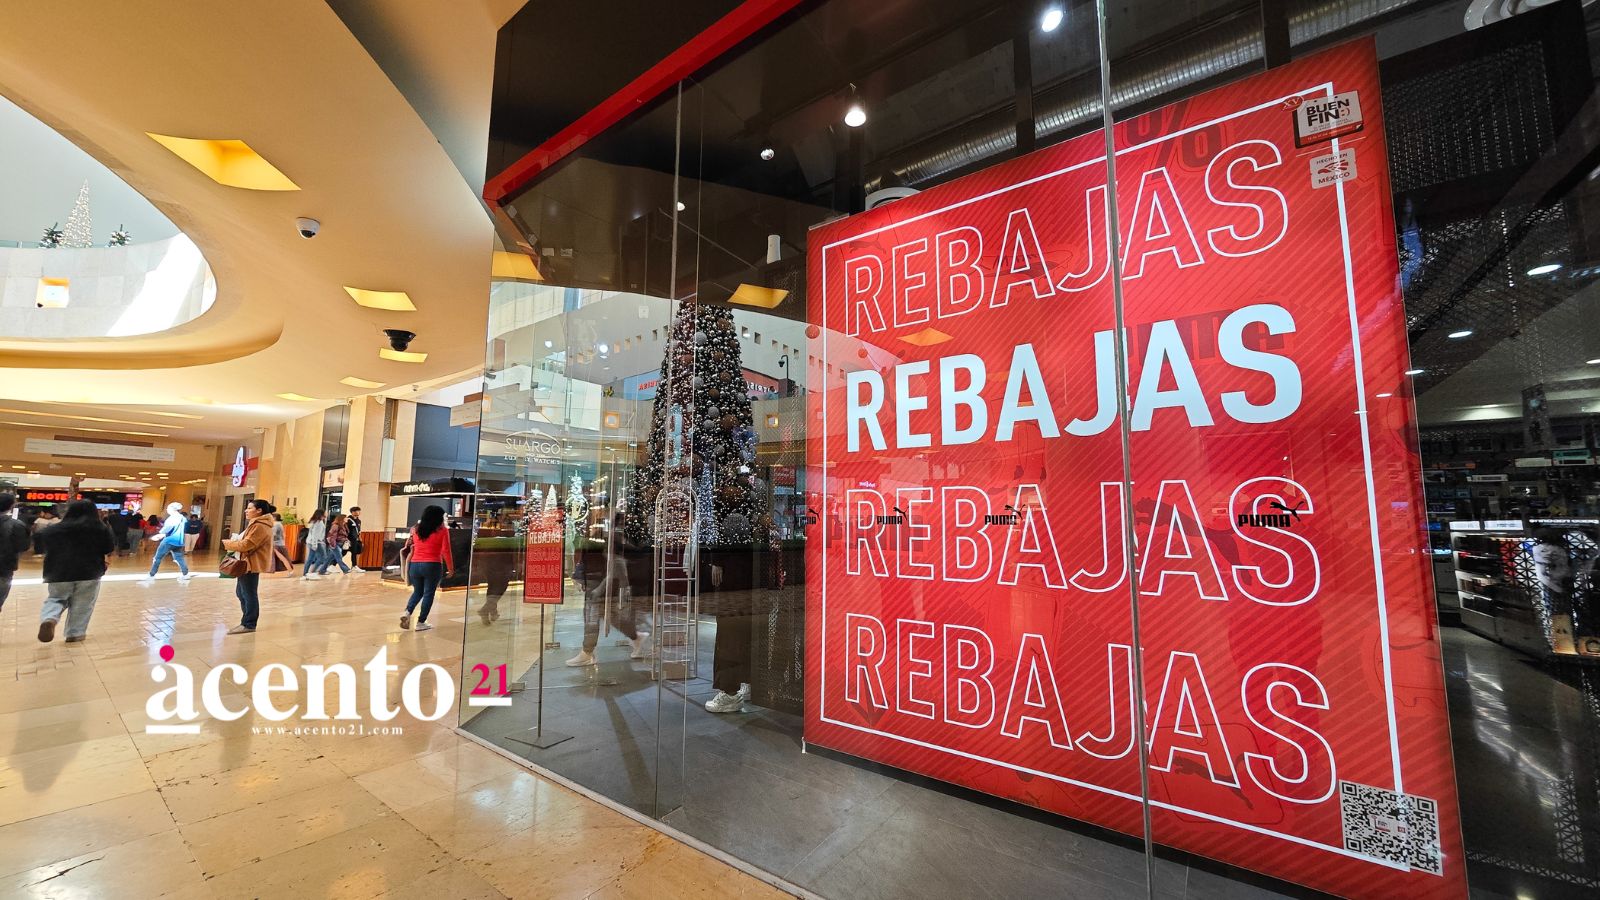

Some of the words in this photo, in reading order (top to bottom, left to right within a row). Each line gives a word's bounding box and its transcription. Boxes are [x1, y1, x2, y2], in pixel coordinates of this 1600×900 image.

[1306, 99, 1350, 116] BUEN
[845, 138, 1289, 337] REBAJAS
[846, 303, 1303, 453] REBAJAS
[876, 515, 903, 525] PUMA
[984, 514, 1017, 525] PUMA
[1238, 514, 1291, 527] PUMA
[529, 530, 560, 544] REBAJAS
[845, 474, 1321, 608] REBAJAS
[845, 612, 1336, 805] REBAJAS
